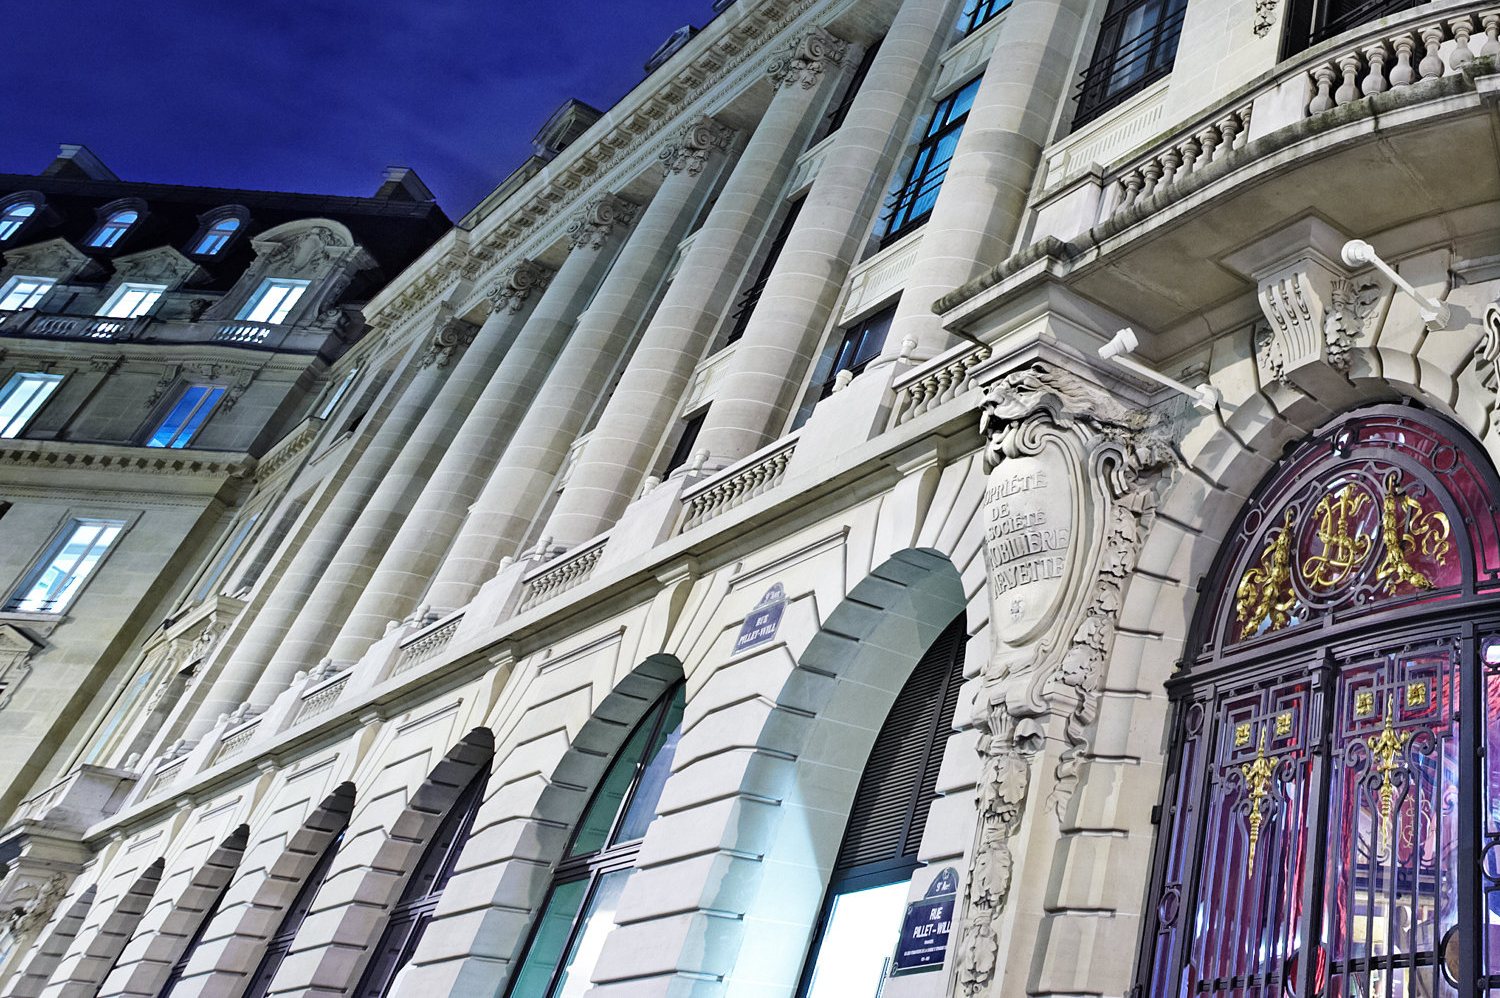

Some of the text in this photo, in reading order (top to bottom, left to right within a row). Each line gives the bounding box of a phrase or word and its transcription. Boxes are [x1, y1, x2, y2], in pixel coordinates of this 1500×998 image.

[983, 470, 1047, 508] OPRIÉTÉ
[992, 502, 1011, 522] DE
[929, 906, 943, 921] RUE
